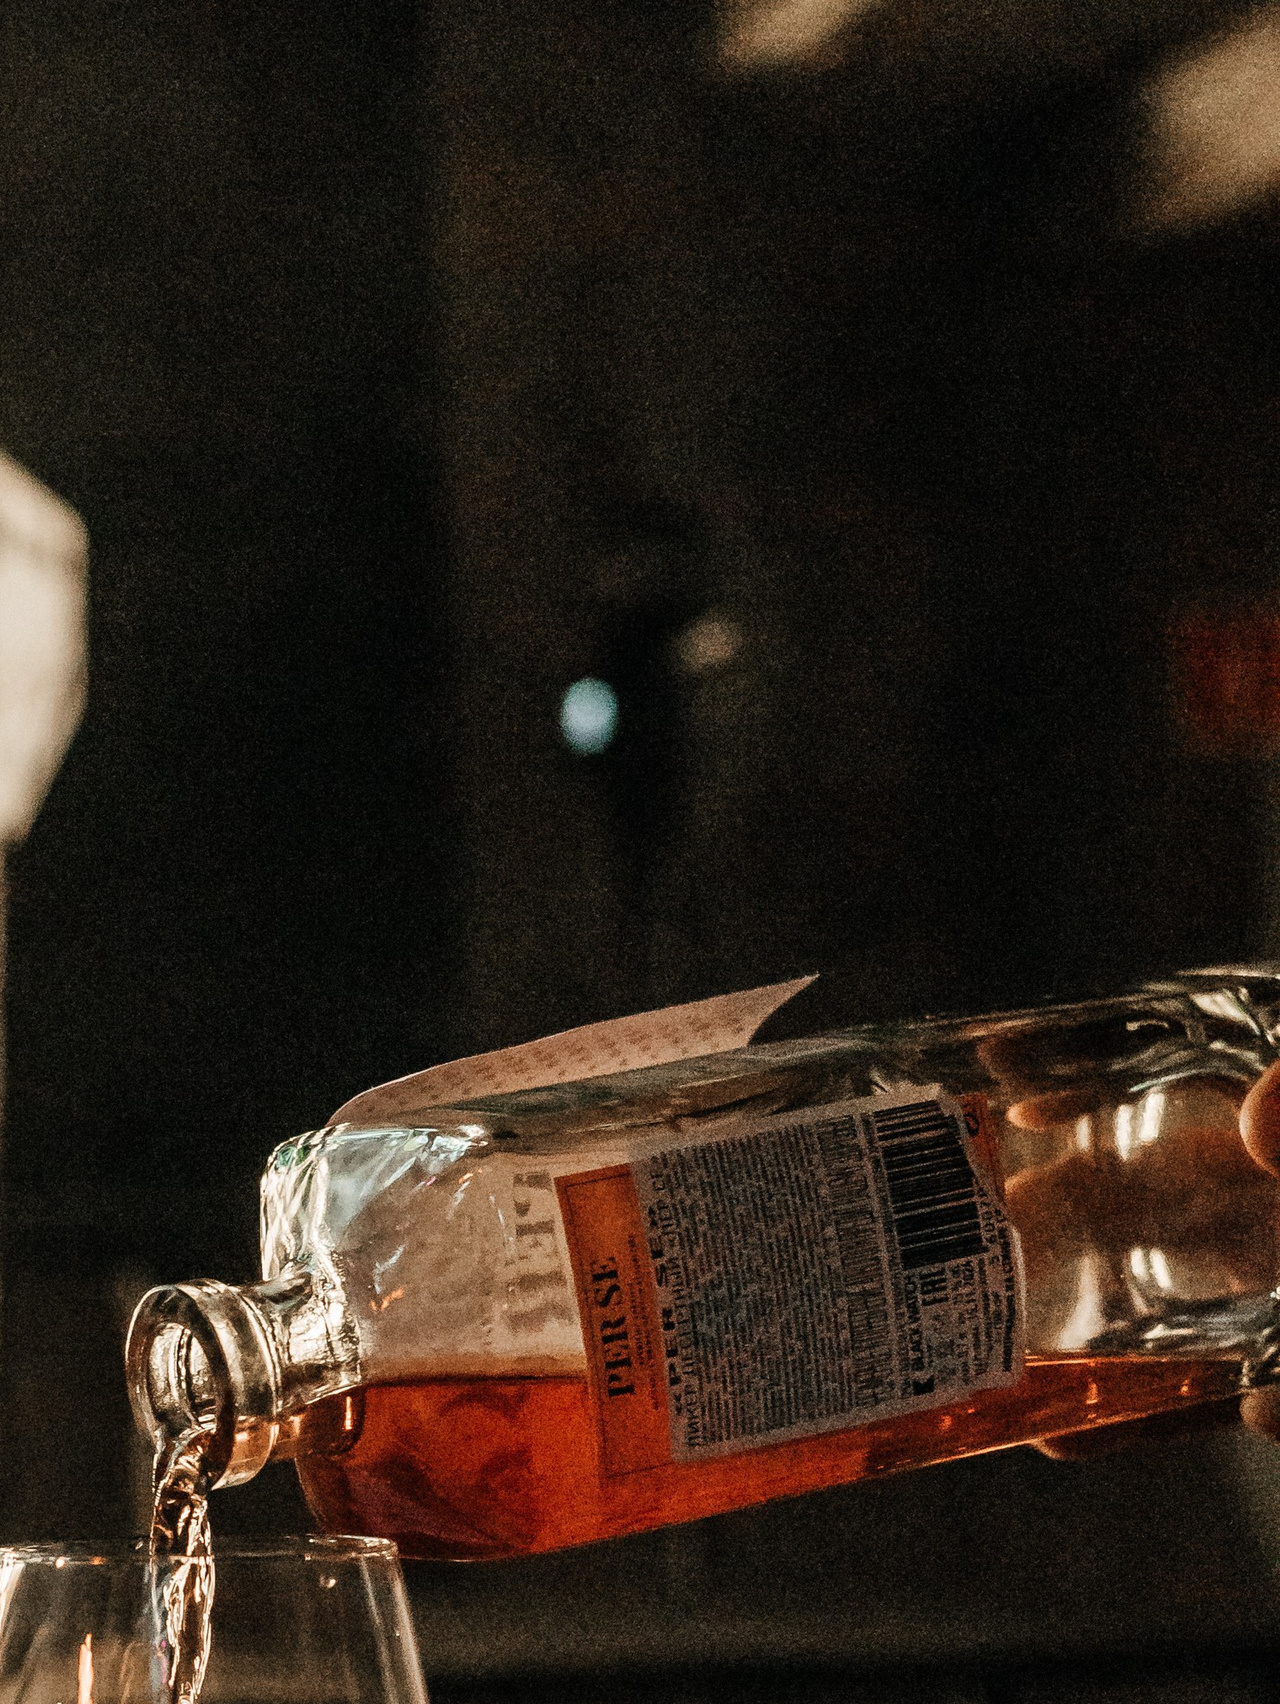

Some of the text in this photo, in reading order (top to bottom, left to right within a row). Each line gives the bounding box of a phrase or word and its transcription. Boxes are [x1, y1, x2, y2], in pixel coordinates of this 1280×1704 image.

[591, 1257, 634, 1398] PER SE
[903, 1274, 924, 1372] BLACK WATCH
